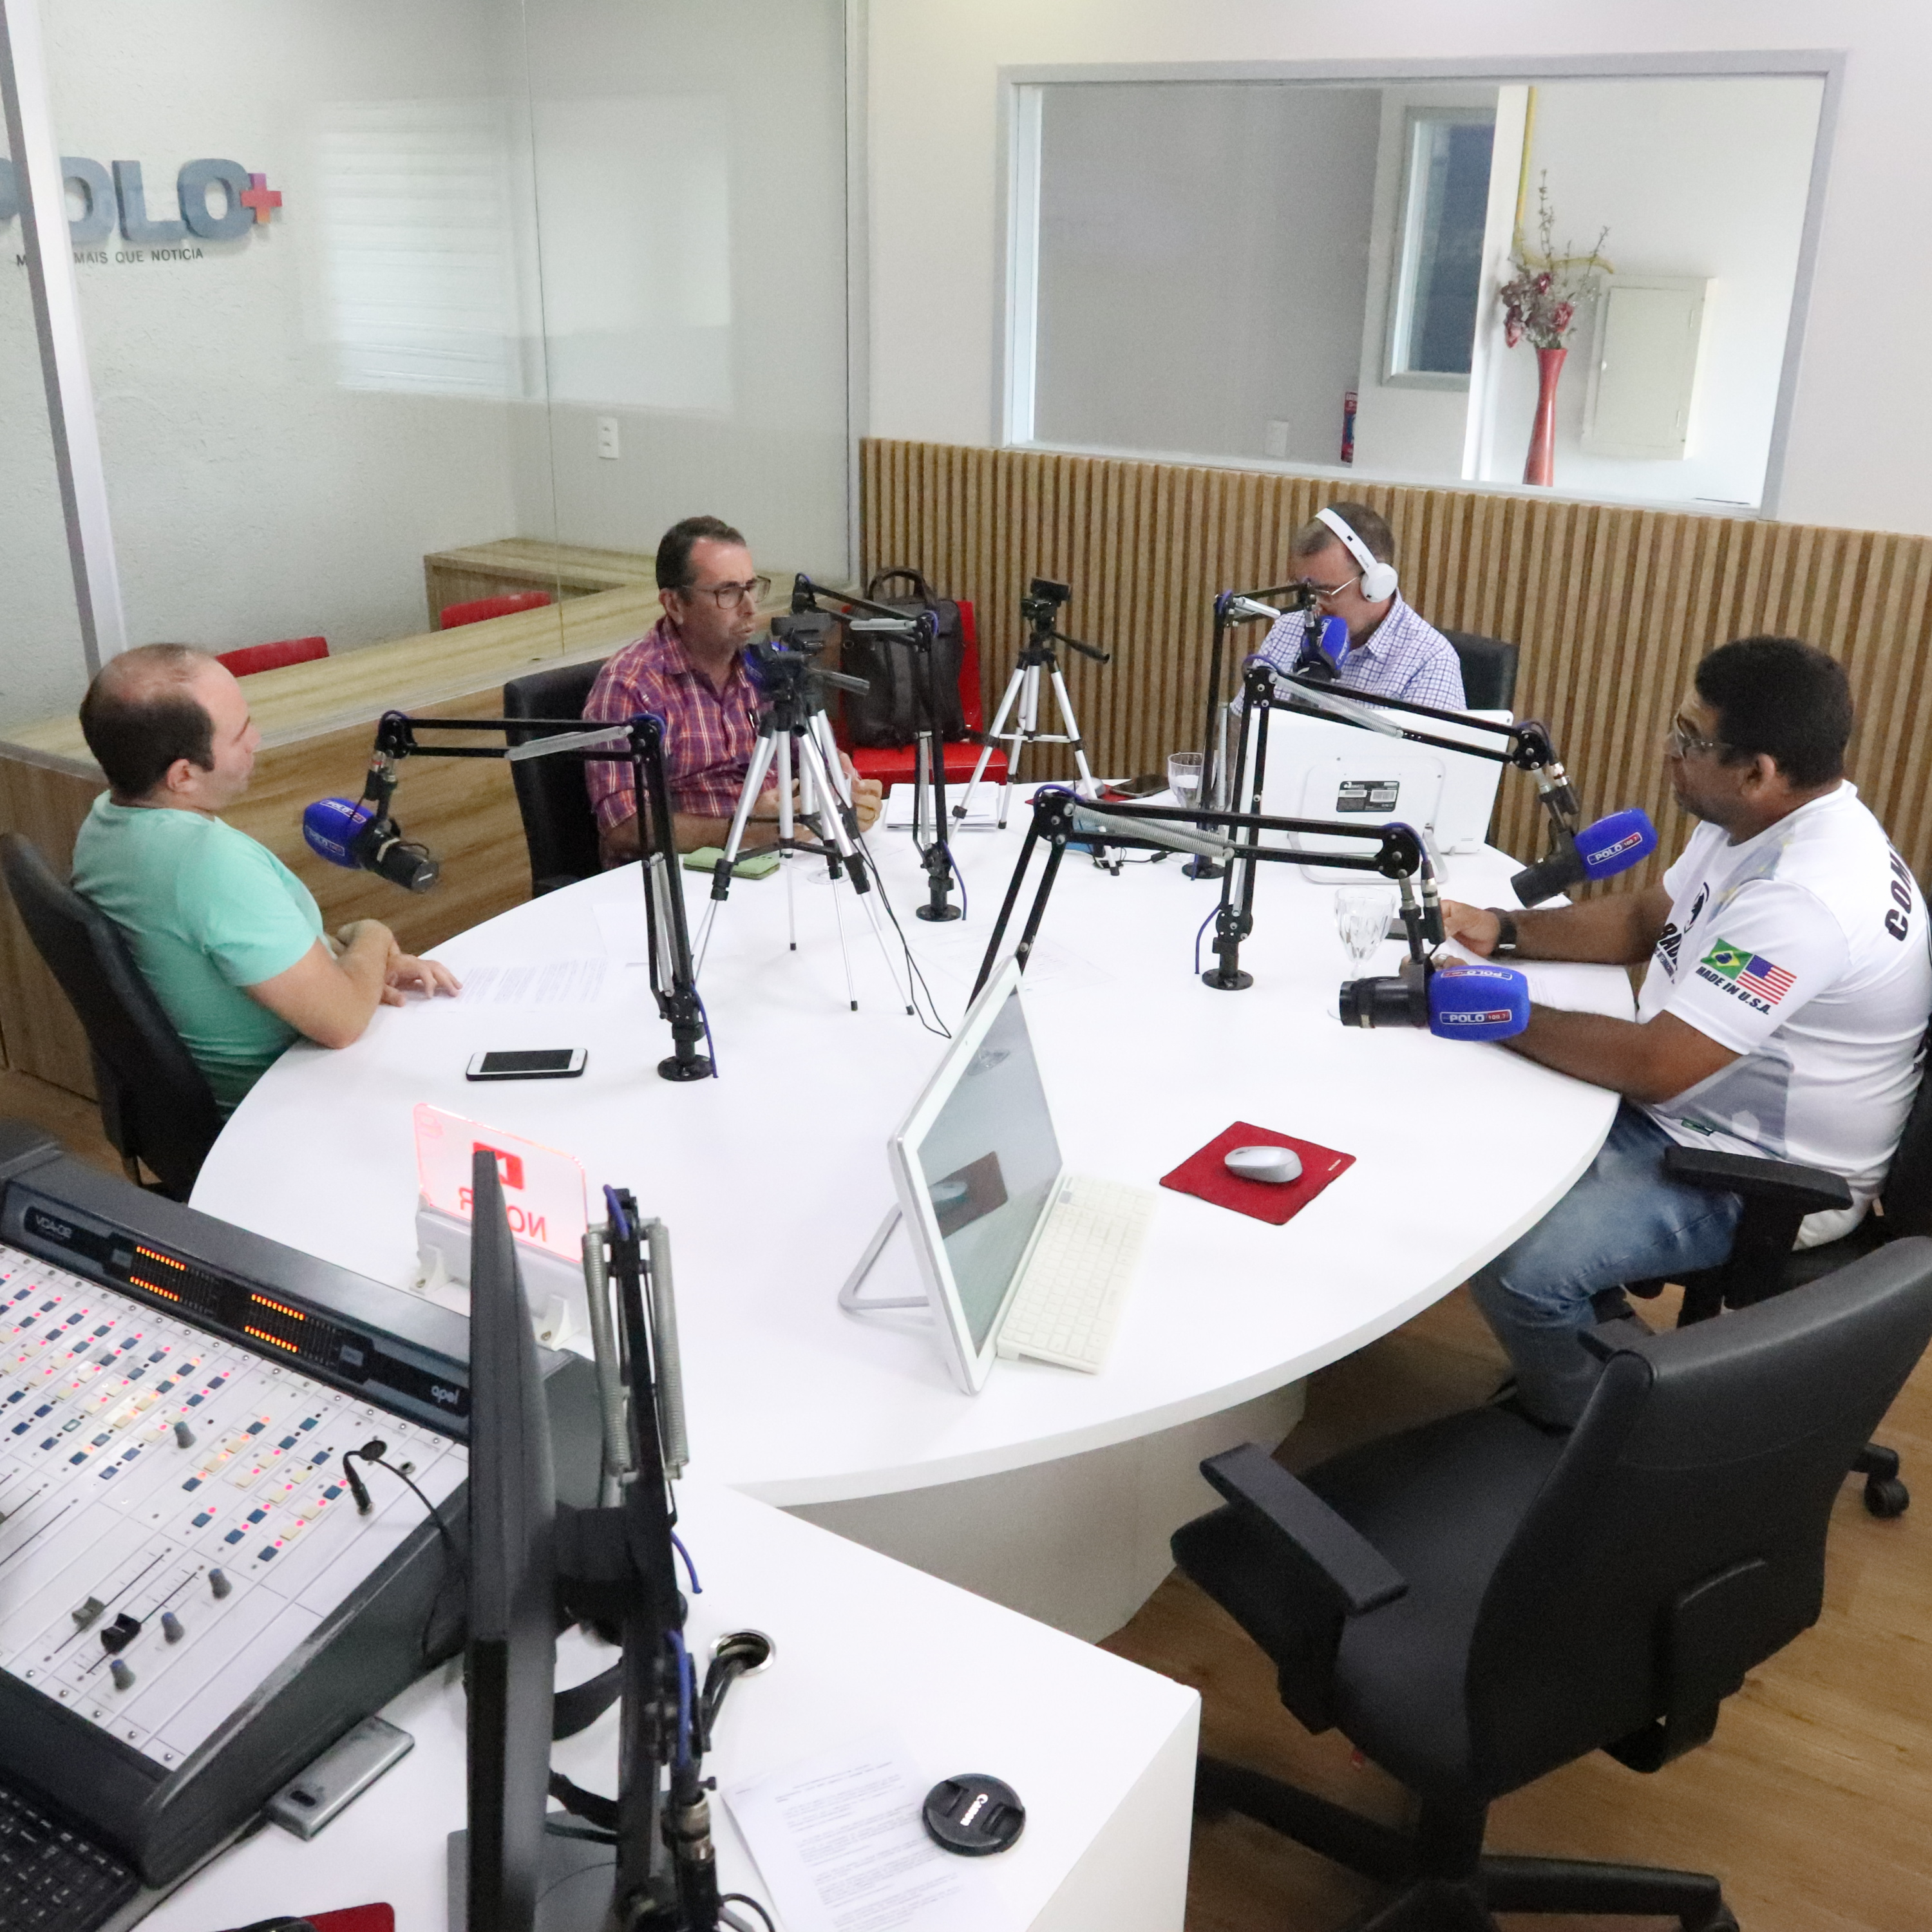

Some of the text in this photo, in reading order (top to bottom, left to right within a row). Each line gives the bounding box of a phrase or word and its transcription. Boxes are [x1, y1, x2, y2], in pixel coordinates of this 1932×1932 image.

[73, 248, 204, 264] MAIS QUE NOTICIA
[1595, 844, 1622, 861] POLO
[1695, 966, 1726, 987] MADE
[1721, 982, 1741, 995] IN
[1449, 1014, 1485, 1023] POLO
